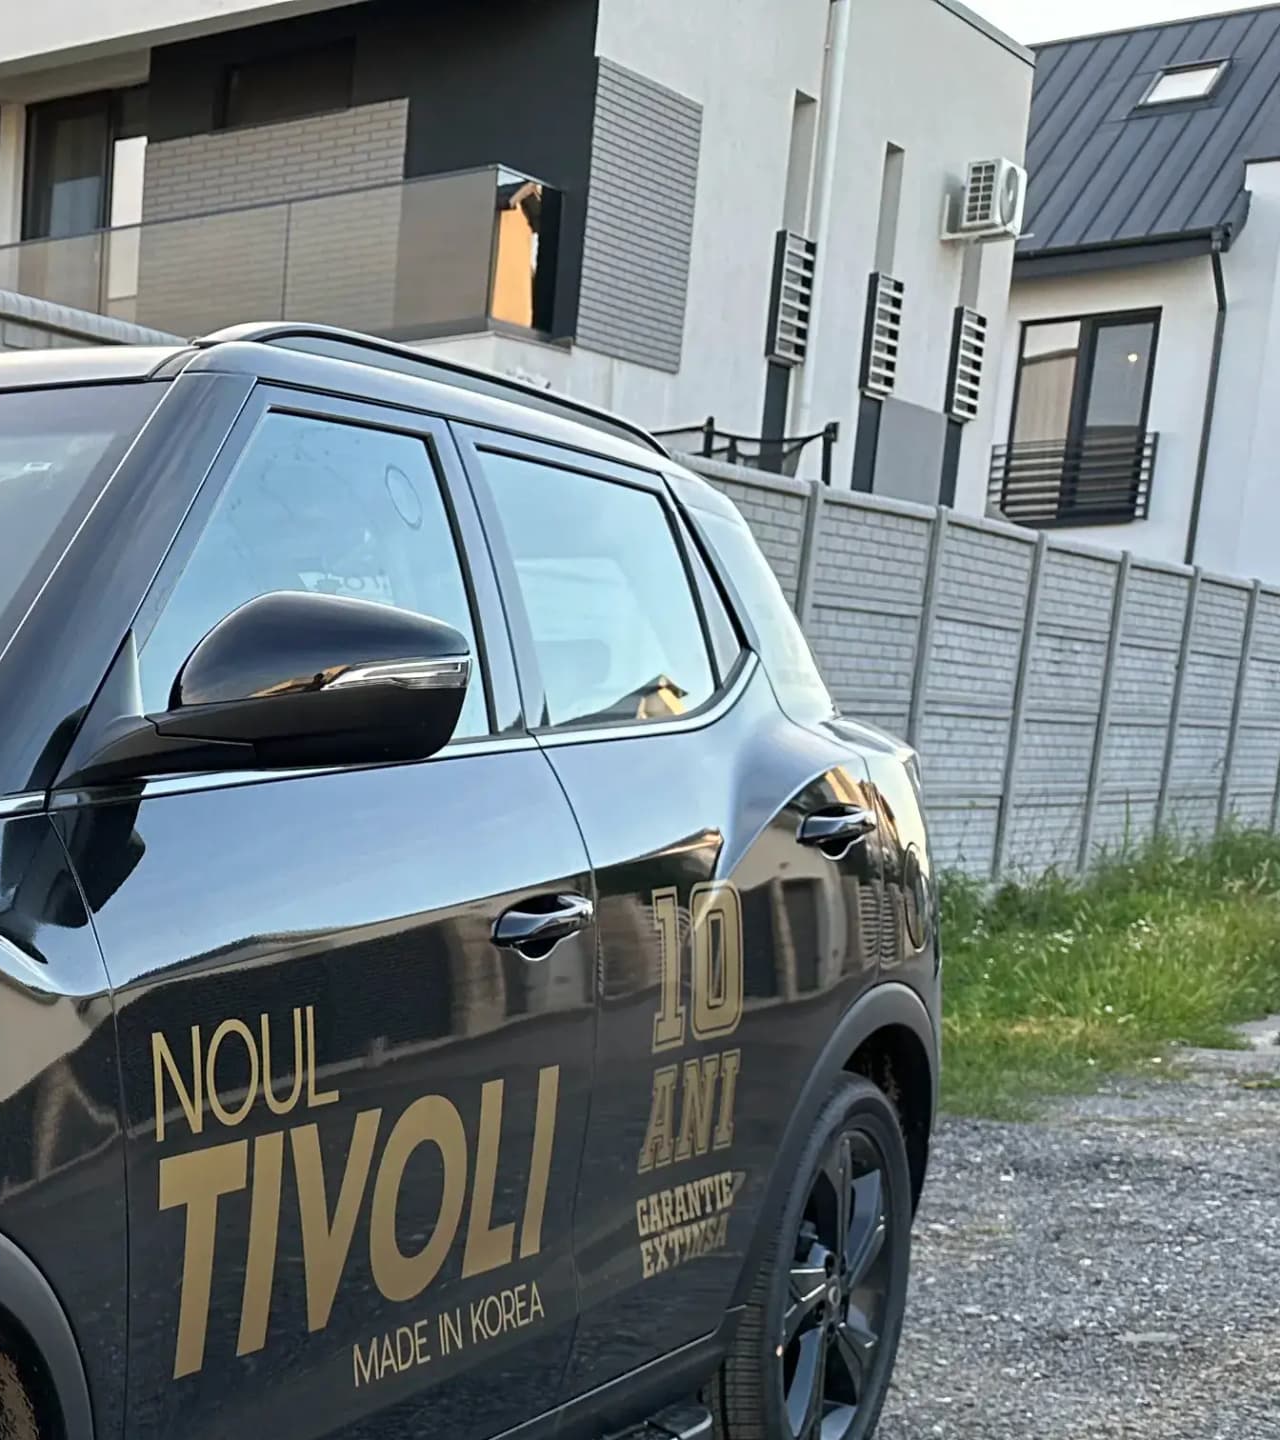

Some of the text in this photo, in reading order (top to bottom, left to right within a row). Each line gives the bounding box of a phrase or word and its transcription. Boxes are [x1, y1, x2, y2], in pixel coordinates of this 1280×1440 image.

[651, 880, 743, 1053] 10
[152, 1005, 339, 1142] NOUL
[637, 1049, 740, 1174] ANI
[159, 1064, 559, 1380] TIVOLI
[636, 1171, 734, 1237] GARANTIE
[353, 1281, 544, 1387] MADE IN KOREA
